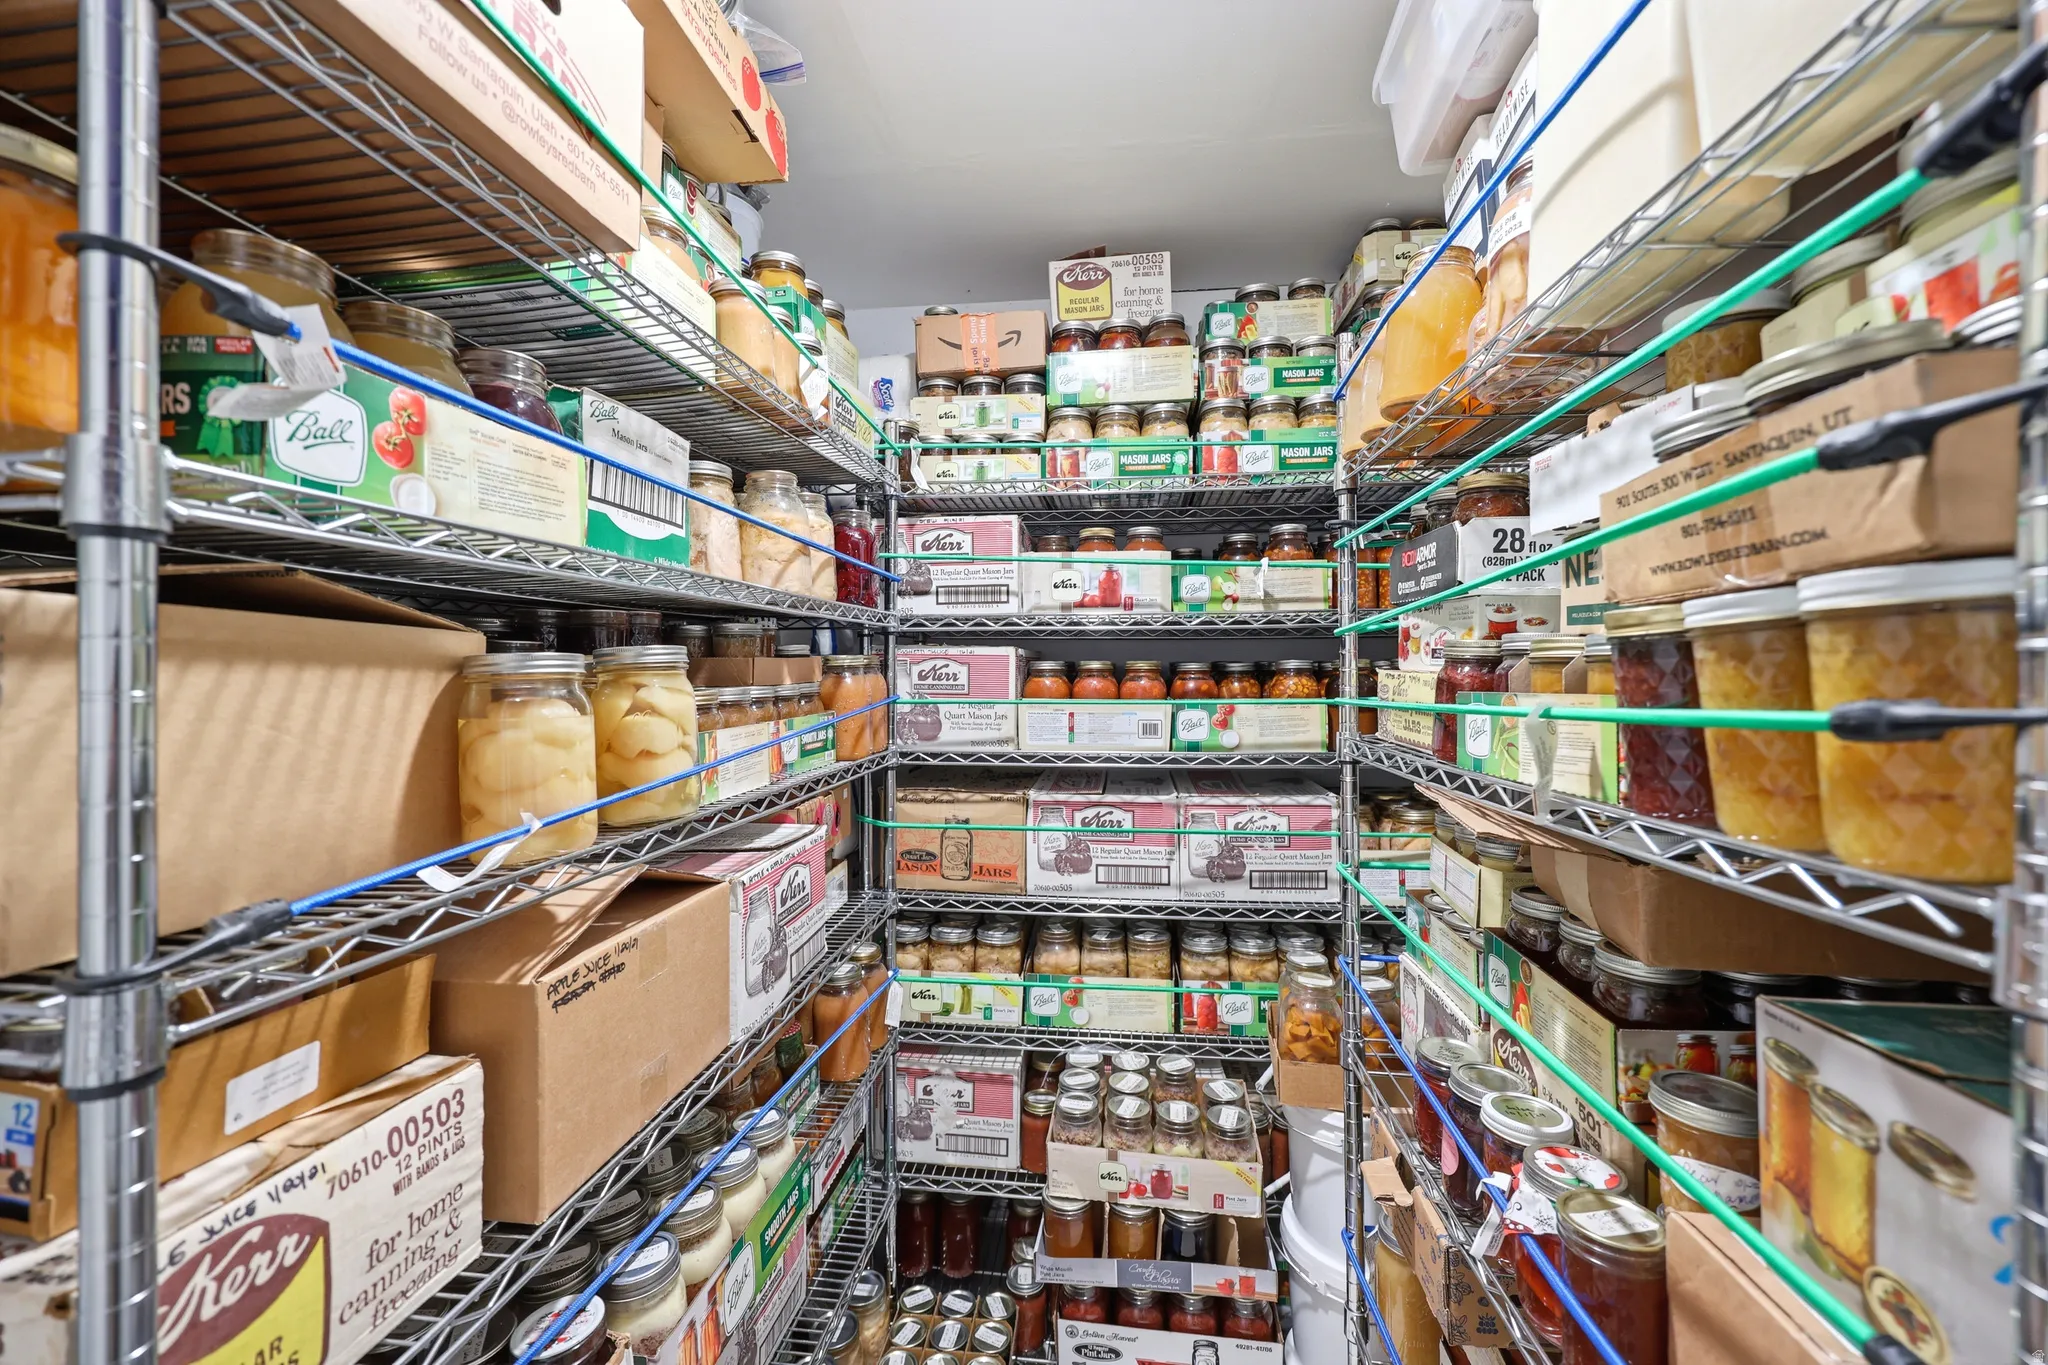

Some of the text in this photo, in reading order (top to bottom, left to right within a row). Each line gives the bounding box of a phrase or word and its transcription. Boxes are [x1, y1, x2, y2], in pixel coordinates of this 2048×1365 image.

[418, 24, 597, 194] Follow us @rowleysredbarn
[1495, 78, 1530, 150] READYWISE
[531, 103, 557, 141] Utah
[1448, 150, 1475, 208] READYWISE
[1063, 263, 1107, 284] Kerr
[1124, 285, 1164, 297] for home
[1064, 304, 1105, 315] MASON JARS
[1069, 296, 1100, 306] REGULAR
[1115, 295, 1165, 310] canning &
[1282, 368, 1325, 379] MASON JARS
[879, 381, 895, 408] Scott
[589, 399, 620, 423] Ball
[286, 408, 355, 451] Ball
[611, 427, 636, 446] Mason
[635, 438, 648, 453] Jars
[1120, 453, 1172, 465] MASON JARS
[1245, 449, 1270, 466] Ball
[1281, 446, 1334, 458] MASON JARS
[1615, 495, 1631, 510] 901
[1632, 483, 1660, 506] SOUTH
[1661, 473, 1680, 493] 300
[1822, 406, 1854, 433] UT
[921, 532, 965, 552] Kerr
[1493, 527, 1553, 554] 28 fl oz
[940, 568, 962, 577] Regular
[963, 568, 981, 577] Quart
[982, 568, 1002, 576] Mason
[1002, 568, 1014, 576] Jars
[1516, 568, 1546, 582] PACK
[1053, 578, 1078, 590] Kerr
[1184, 581, 1208, 597] Ball
[918, 663, 960, 682] Kerr
[944, 710, 1008, 721] Quart Mason Jars
[1180, 717, 1207, 732] Ball
[1467, 715, 1488, 743] Ball
[1081, 810, 1125, 829] Kerr
[1100, 847, 1122, 856] Regular
[1124, 847, 1142, 855] Quart
[1143, 848, 1163, 856] Mason
[1164, 848, 1176, 856] Jars
[1279, 853, 1298, 861] Quart
[1299, 852, 1320, 860] Mason
[1321, 852, 1333, 861] Jars
[973, 864, 1012, 878] JARS
[780, 869, 808, 908] Kerr
[547, 967, 581, 1001] APPLE
[583, 951, 612, 978] JUICE
[1491, 968, 1507, 987] Ball
[912, 988, 937, 1001] Kerr
[1033, 993, 1057, 1007] Ball
[1225, 1001, 1249, 1016] Ball
[1497, 1038, 1533, 1082] Kerr
[13, 1101, 34, 1128] 12
[983, 1119, 1002, 1128] Mason
[1002, 1120, 1014, 1129] Jars
[326, 1087, 466, 1199] 70610-00503
[394, 1120, 463, 1175] 12 PINTS
[393, 1134, 466, 1198] WITH BANDS & LIDS
[1100, 1171, 1123, 1182] Kerr
[763, 1186, 799, 1246] SMOOTH JARS
[366, 1181, 464, 1274] for home
[338, 1208, 463, 1326] canning &
[1128, 1263, 1156, 1274] Country
[158, 1225, 312, 1357] Kerr
[370, 1239, 463, 1330] freezing
[728, 1256, 750, 1316] Ball
[1080, 1329, 1139, 1343] Golden Harvest
[1081, 1349, 1116, 1359] Pint Jars
